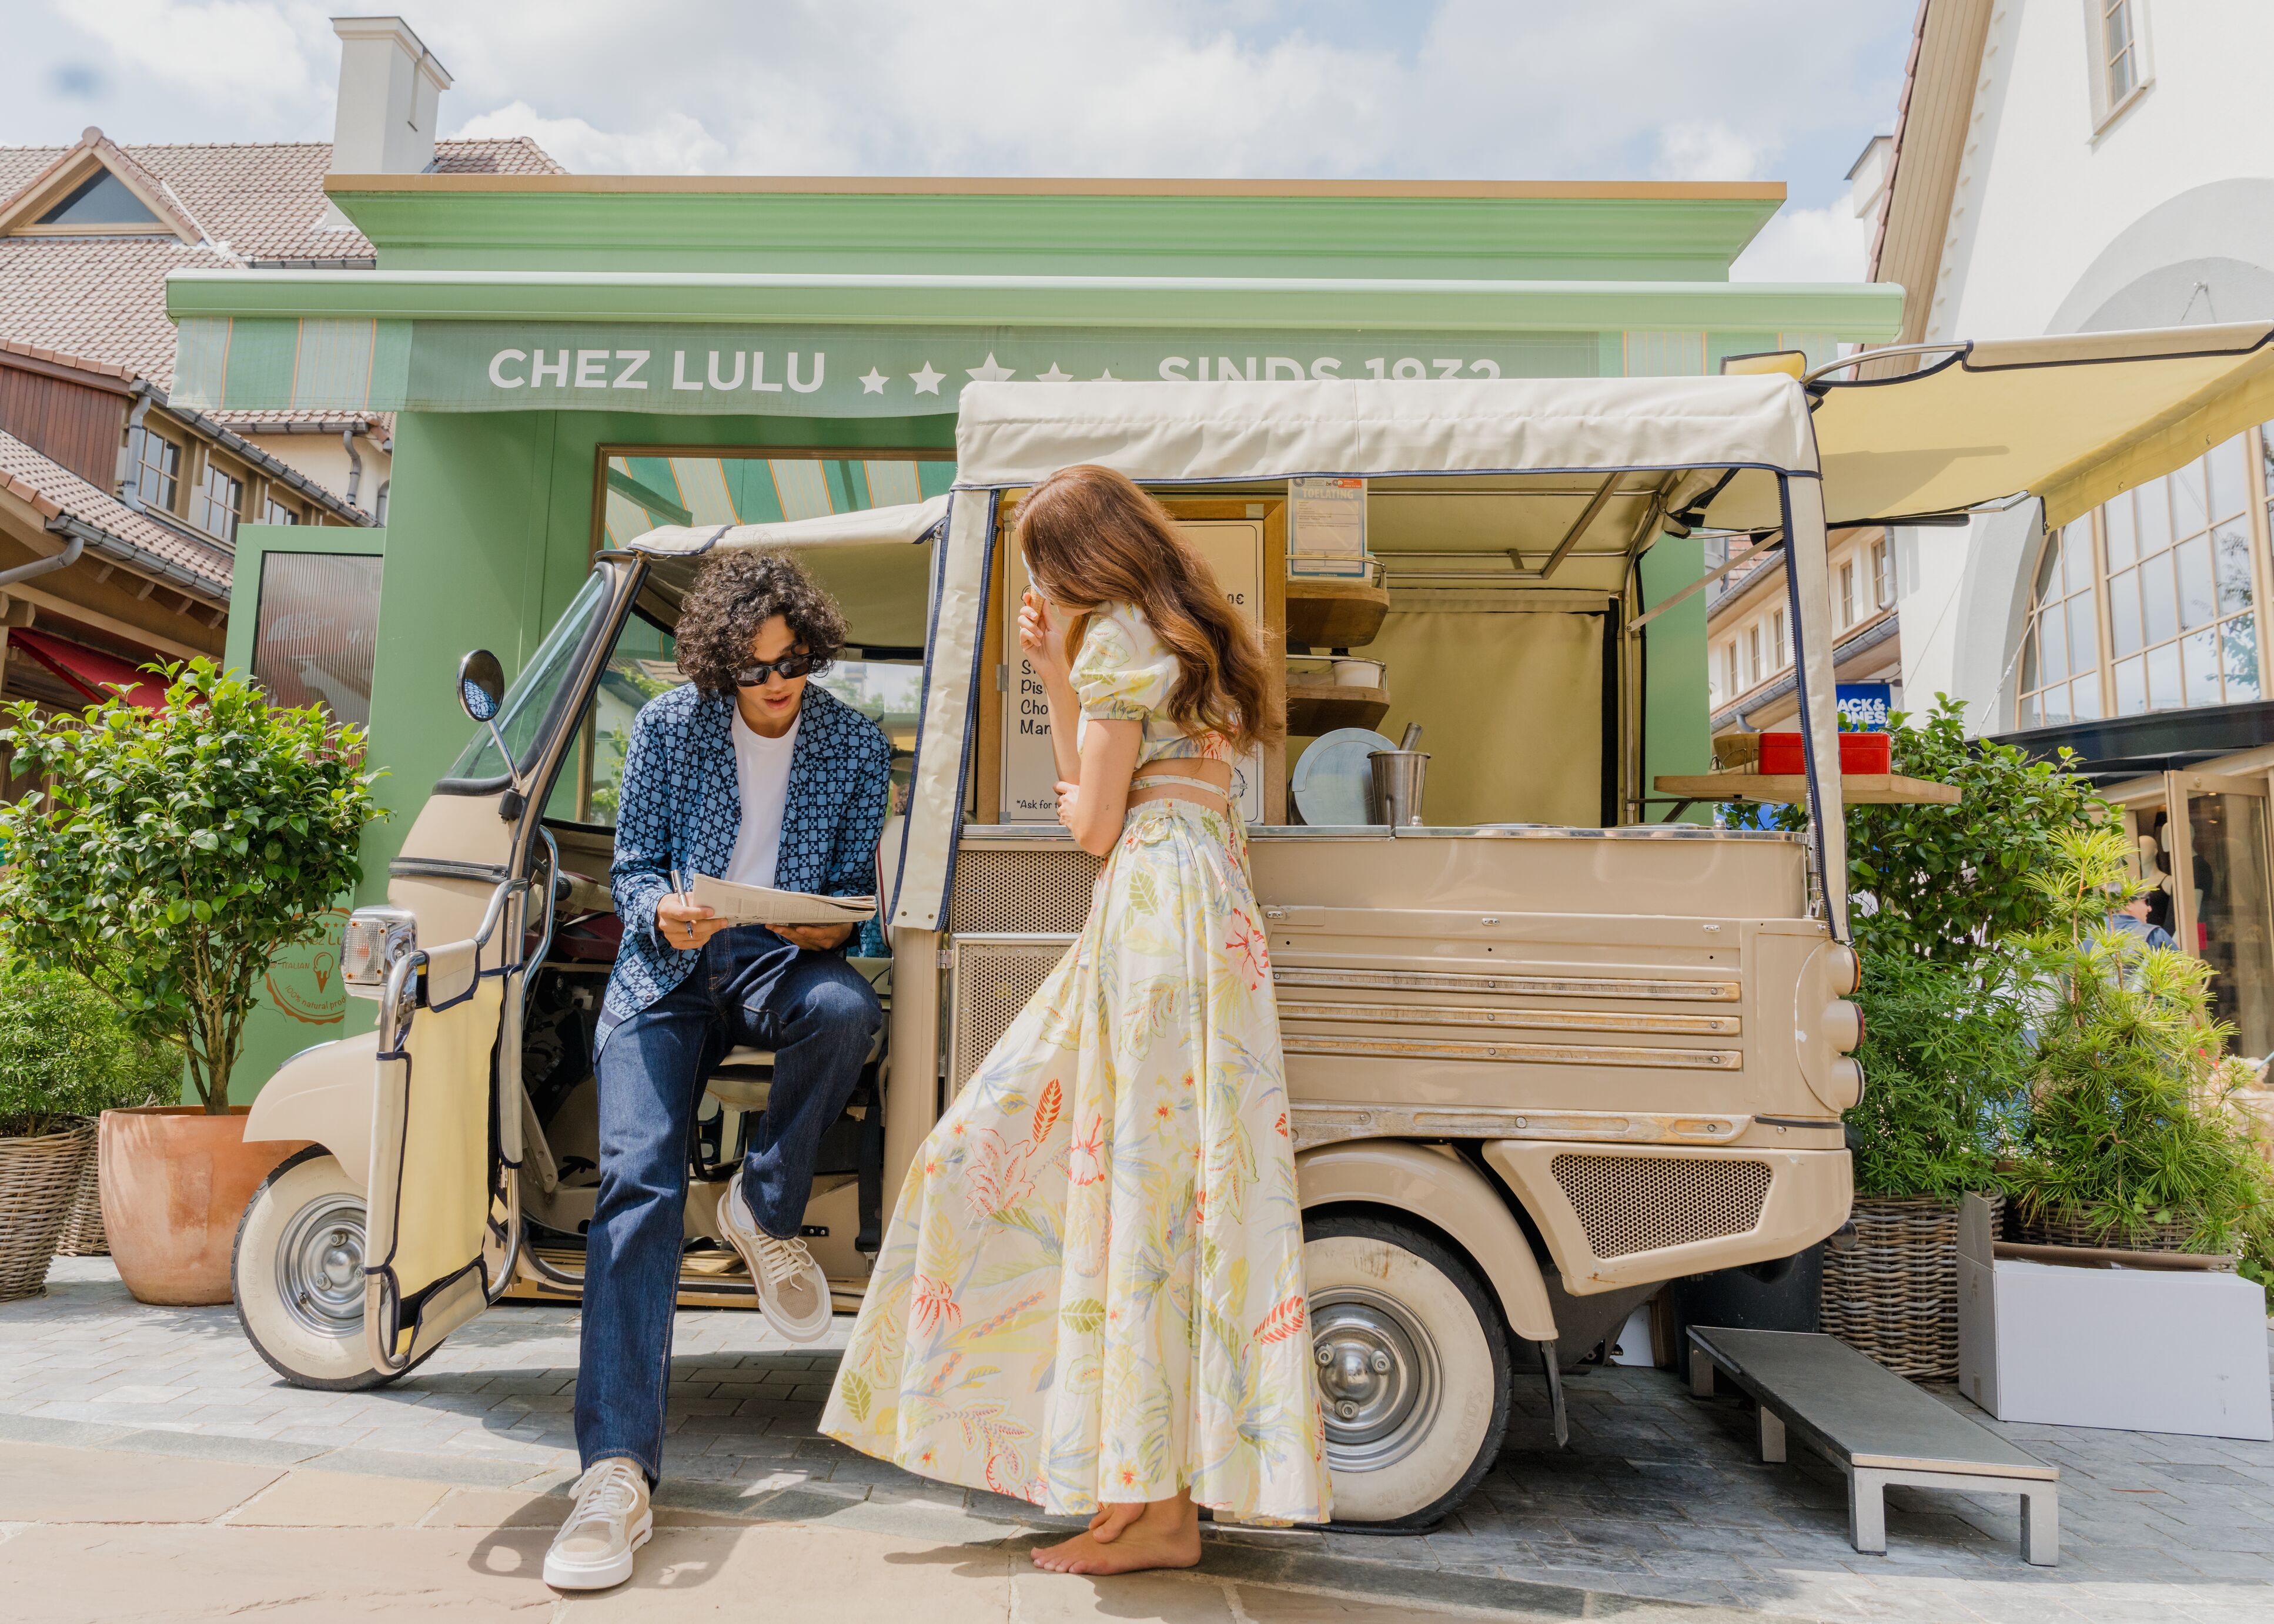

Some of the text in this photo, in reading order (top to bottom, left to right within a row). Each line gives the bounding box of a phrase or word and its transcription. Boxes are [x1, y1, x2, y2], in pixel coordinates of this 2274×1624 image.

[489, 349, 650, 389] CHEZ
[673, 350, 824, 393] LULU
[1158, 356, 1342, 381] SINDS
[1302, 488, 1354, 499] TOELATING
[1021, 679, 1046, 694] Pis
[1021, 699, 1048, 715] Cho
[1837, 698, 1885, 712] ACK&
[1020, 719, 1051, 735] Man
[1039, 800, 1052, 809] for
[285, 985, 346, 1011] 100% natural prod
